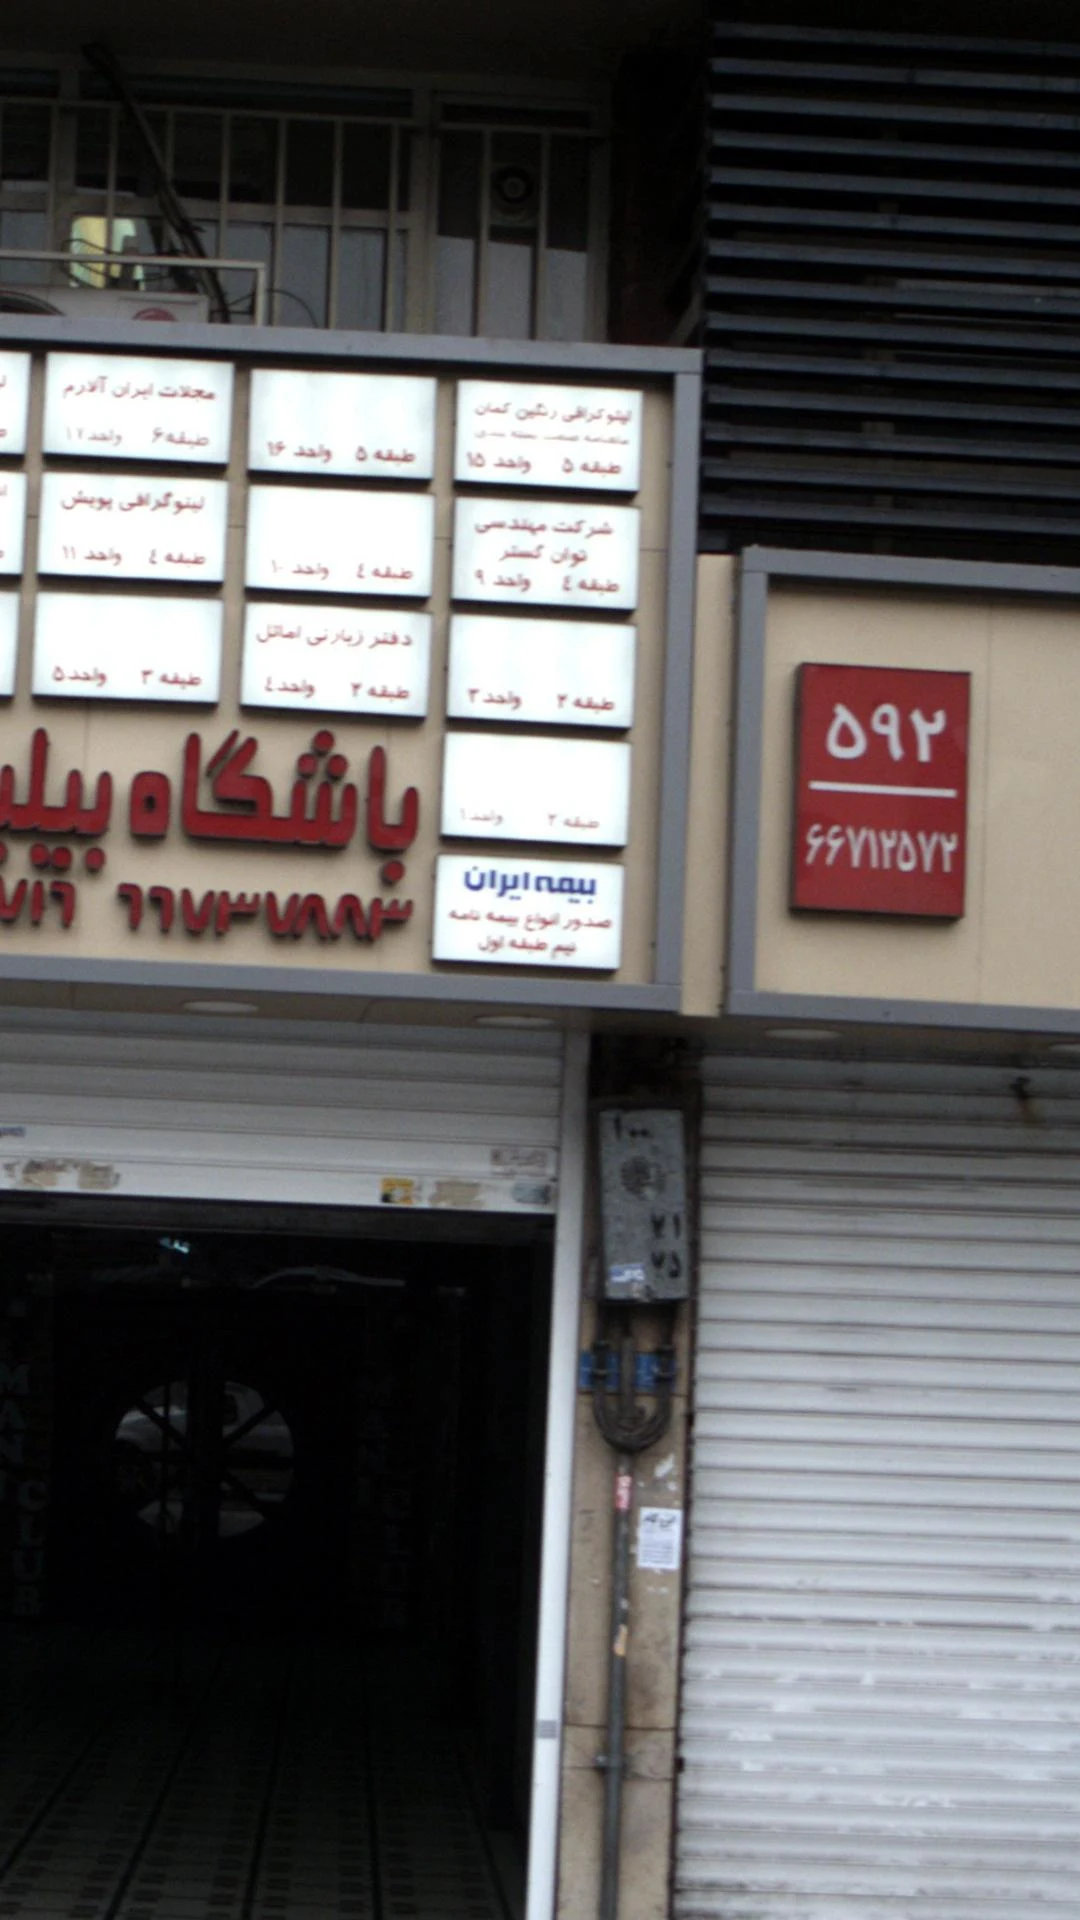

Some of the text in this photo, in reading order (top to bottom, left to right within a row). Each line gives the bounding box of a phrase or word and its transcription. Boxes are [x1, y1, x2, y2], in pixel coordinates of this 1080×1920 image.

[88, 430, 123, 446] واحد
[294, 444, 333, 463] واحد
[374, 448, 417, 467] طبقه
[493, 455, 532, 475] واحد
[579, 460, 622, 478] طبقه
[552, 519, 614, 539] شرکت
[84, 548, 123, 567] واحد
[164, 551, 206, 568] طبقه
[291, 562, 330, 581] واحد
[371, 565, 414, 582] طبقه
[493, 573, 532, 593] واحد
[577, 577, 621, 596] طبقه
[68, 668, 107, 686] واحد
[159, 666, 202, 686] طبقه
[277, 679, 317, 698] واحد
[367, 684, 411, 703] طبقه
[483, 691, 522, 711] واحد
[572, 696, 616, 714] طبقه
[826, 703, 947, 763] ۵۹۲
[805, 824, 957, 873] ۶۶۷۱۲۵۷۲
[463, 865, 598, 905] بیمه ایران
[563, 917, 613, 931] صدور
[508, 937, 549, 954] طبقه
